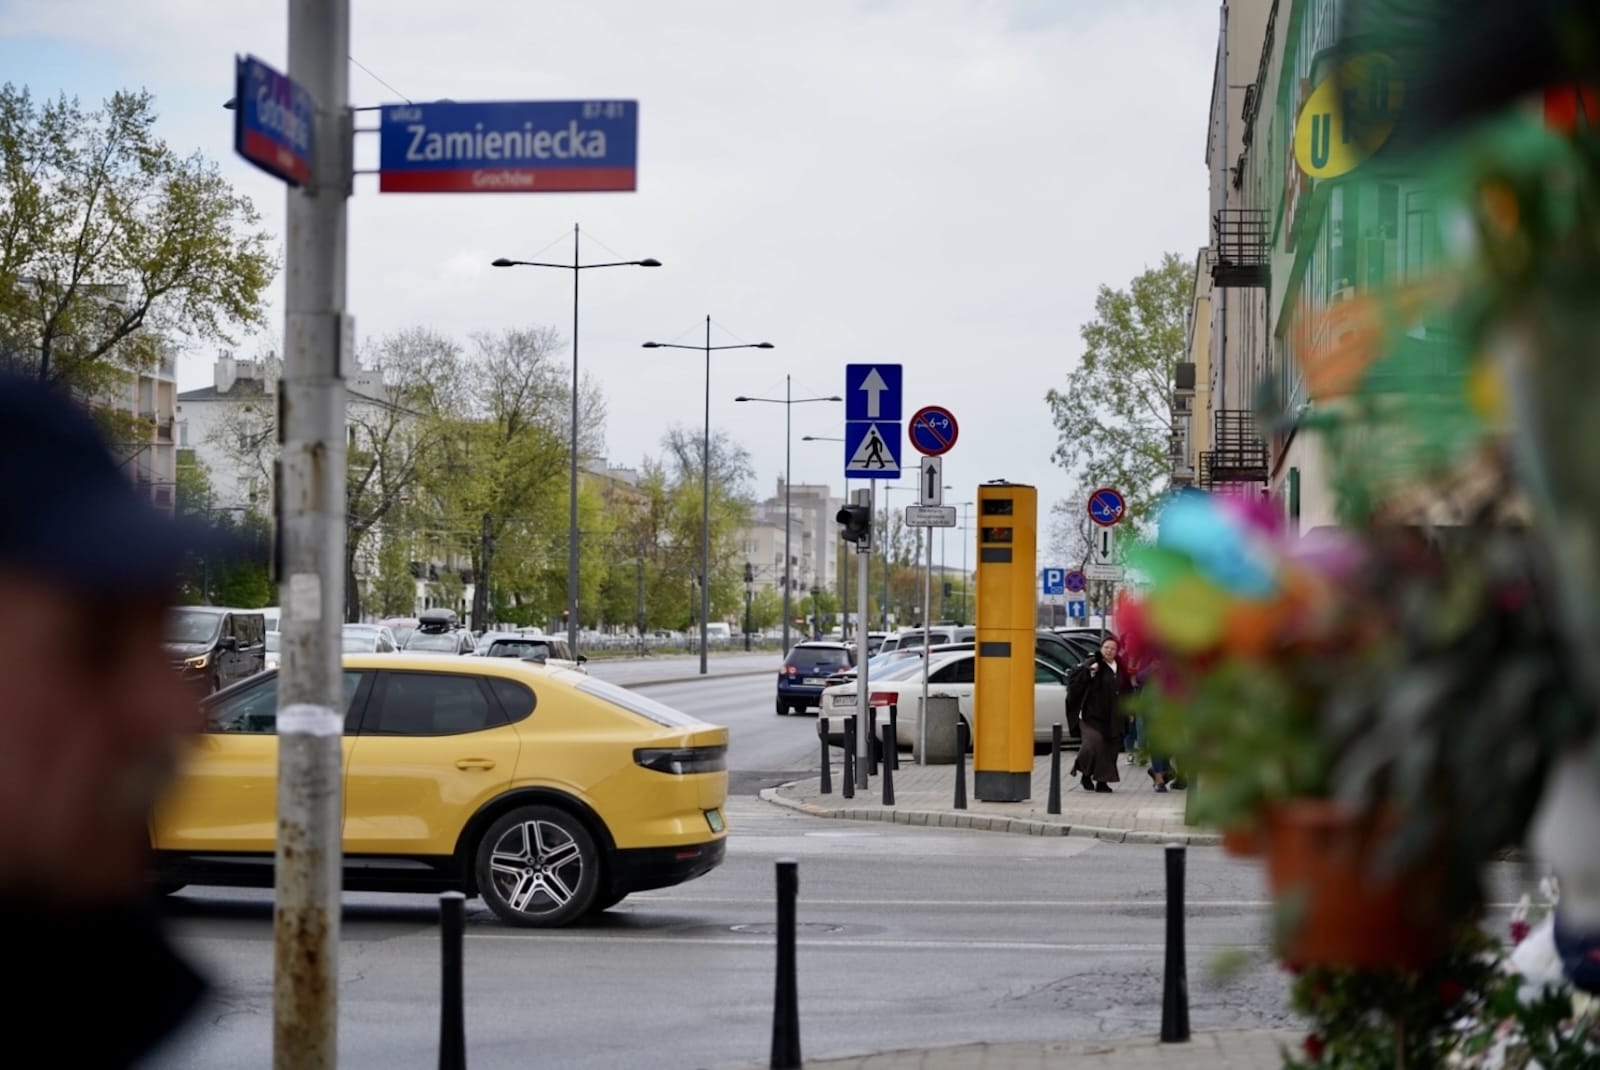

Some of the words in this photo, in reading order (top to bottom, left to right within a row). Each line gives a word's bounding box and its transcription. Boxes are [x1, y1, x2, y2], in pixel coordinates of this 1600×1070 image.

[391, 107, 422, 121] ulica
[406, 121, 607, 162] Zamieniecka
[472, 169, 534, 187] Grochów
[1048, 570, 1061, 587] P
